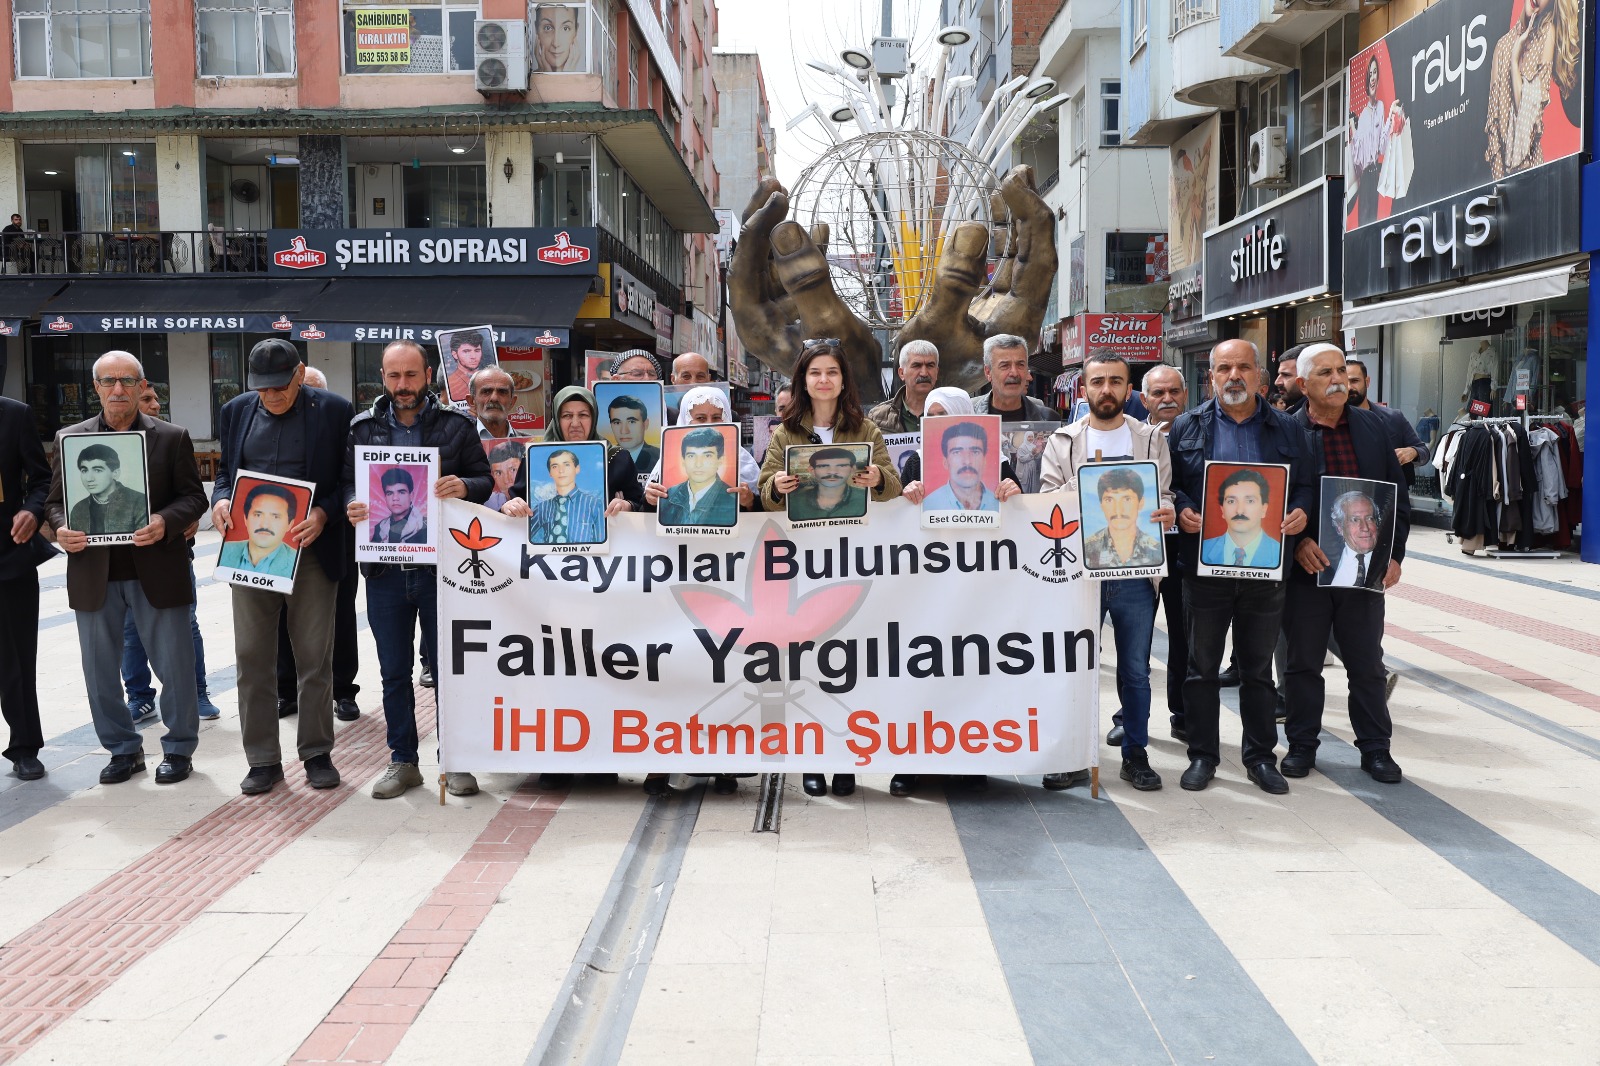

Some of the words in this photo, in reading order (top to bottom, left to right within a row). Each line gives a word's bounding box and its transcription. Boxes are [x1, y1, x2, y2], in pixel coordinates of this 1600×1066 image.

[357, 12, 408, 26] SAHİBİNDEN
[358, 52, 375, 62] 0532
[376, 52, 389, 62] 553
[390, 52, 399, 62] 58
[399, 51, 409, 62] 85
[1411, 14, 1488, 102] rays
[1380, 195, 1494, 269] rays
[335, 231, 410, 271] ŞEHİR
[418, 238, 527, 264] SOFRASI
[542, 248, 583, 262] şenpiliç
[1230, 218, 1283, 283] stilife
[279, 252, 320, 266] şenpiliç
[101, 315, 158, 332] ŞEHİR
[164, 318, 245, 329] SOFRASI
[1099, 316, 1147, 334] Şirin
[1299, 316, 1327, 340] stilife
[354, 326, 415, 341] ŞEHİR
[1089, 333, 1157, 344] Collection
[884, 436, 914, 446] BRAHİM
[363, 450, 390, 462] EDİP
[394, 451, 432, 464] ÇELİK
[791, 521, 826, 530] MAHMUT
[828, 518, 864, 526] DEMİREL
[929, 515, 949, 524] Eset
[951, 513, 994, 524] GÖKTAYI
[665, 526, 699, 536] M.ŞİRİN
[701, 528, 731, 536] MALTU
[86, 535, 113, 544] ÇETİN
[398, 545, 436, 553] GÖZALTINDA
[379, 554, 414, 562] KAYBEDİLDİ
[520, 543, 746, 593] Kayıplar
[763, 536, 1018, 583] Bulunsun
[232, 571, 249, 583] İSA
[252, 576, 275, 588] GÖK
[1021, 564, 1040, 579] İNSAN
[1042, 575, 1069, 584] HAKLARI
[1052, 568, 1066, 577] 1986
[1089, 570, 1133, 578] ABDULLAH
[1134, 568, 1162, 576] BULUT
[1240, 570, 1270, 579] SEVEN
[458, 585, 488, 595] HAKLARI
[490, 576, 514, 593] DERNEĞİ
[470, 580, 486, 588] 1986
[451, 618, 672, 683] Failler
[693, 620, 1096, 695] Yargılansın
[492, 696, 591, 753] İHD
[612, 709, 825, 758] Batman
[845, 706, 1040, 767] Şubesi
